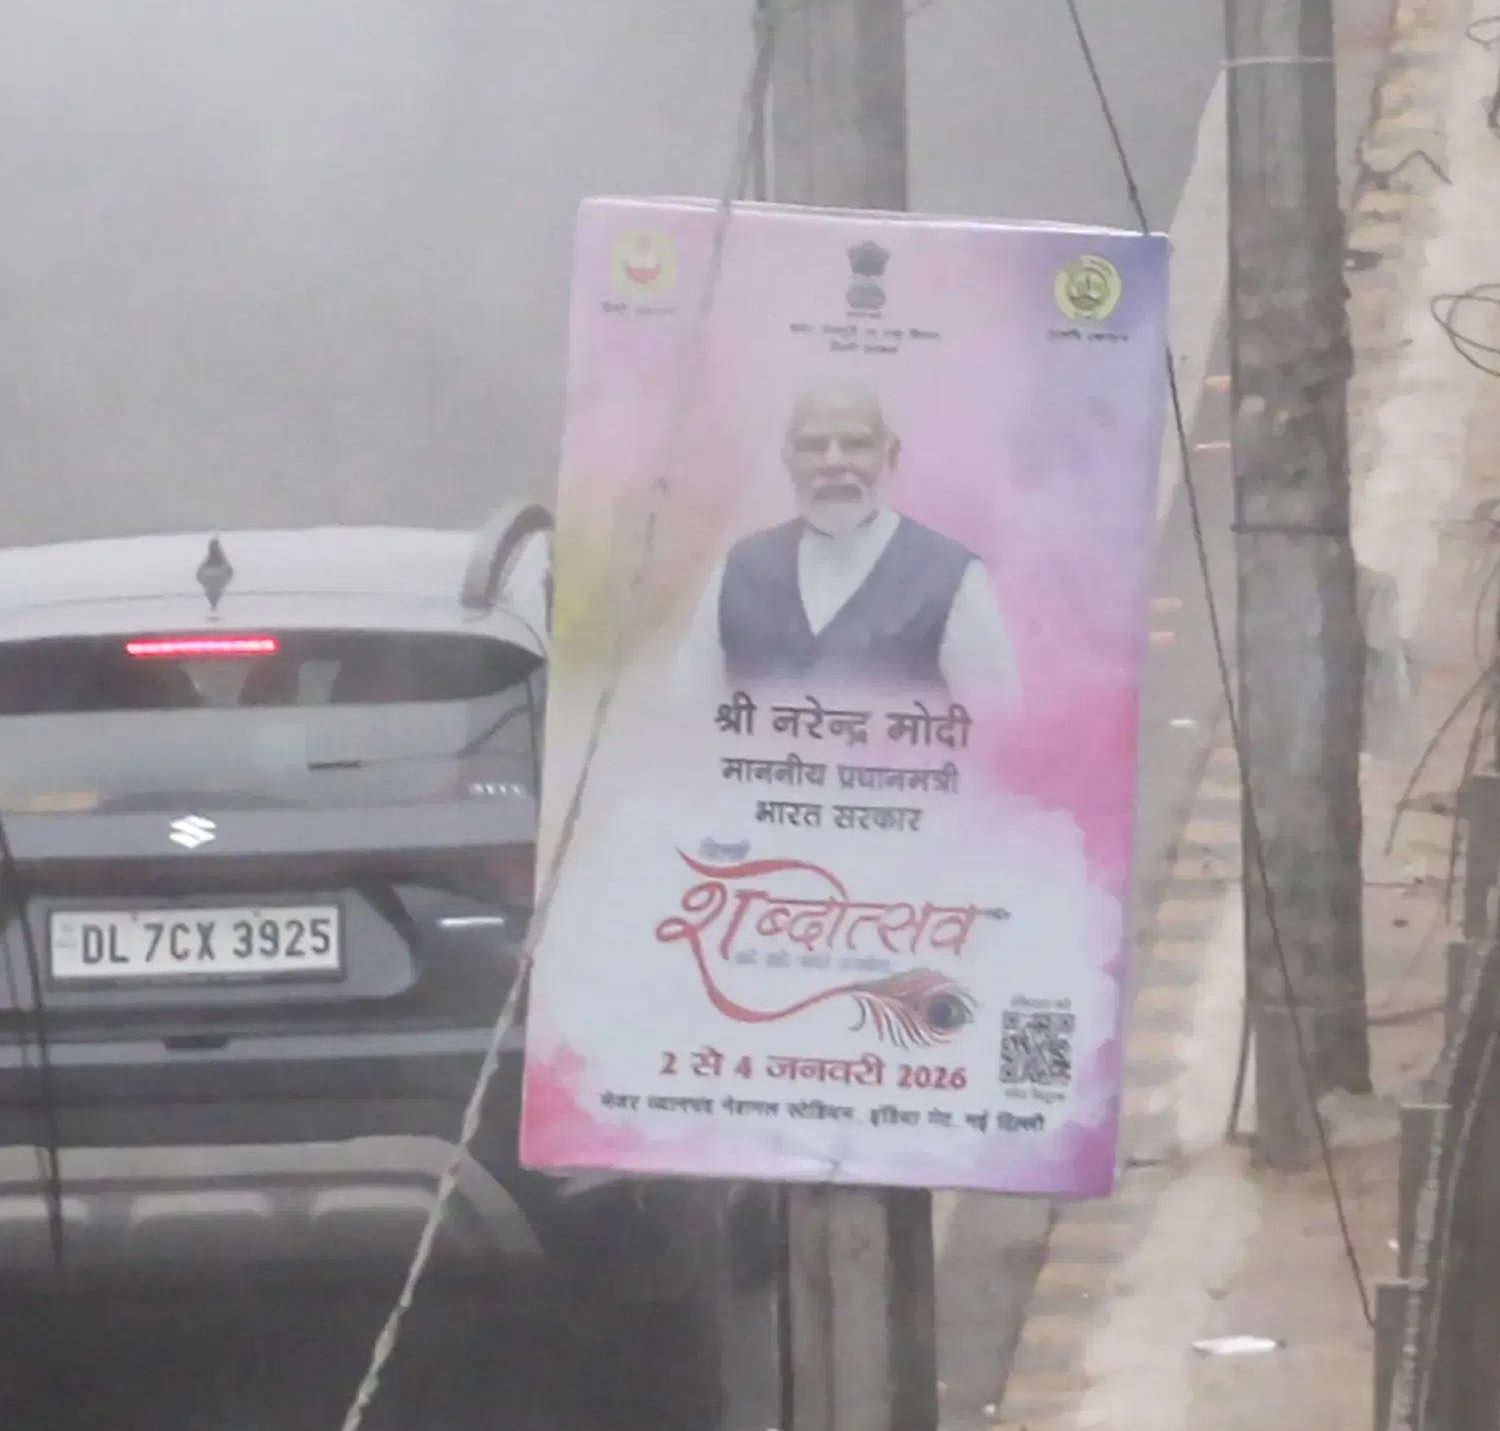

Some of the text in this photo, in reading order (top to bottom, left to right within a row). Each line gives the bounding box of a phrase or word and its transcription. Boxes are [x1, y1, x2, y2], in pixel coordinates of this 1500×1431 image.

[713, 690, 973, 750] श्री नरेन्द्र मोदी
[720, 751, 961, 795] माननीय प्रधानमंत्री
[754, 799, 924, 832] भारत सरकार
[81, 917, 332, 965] DL 7CX 3925
[659, 1045, 968, 1091] 2 से 4 जनवरी 2026
